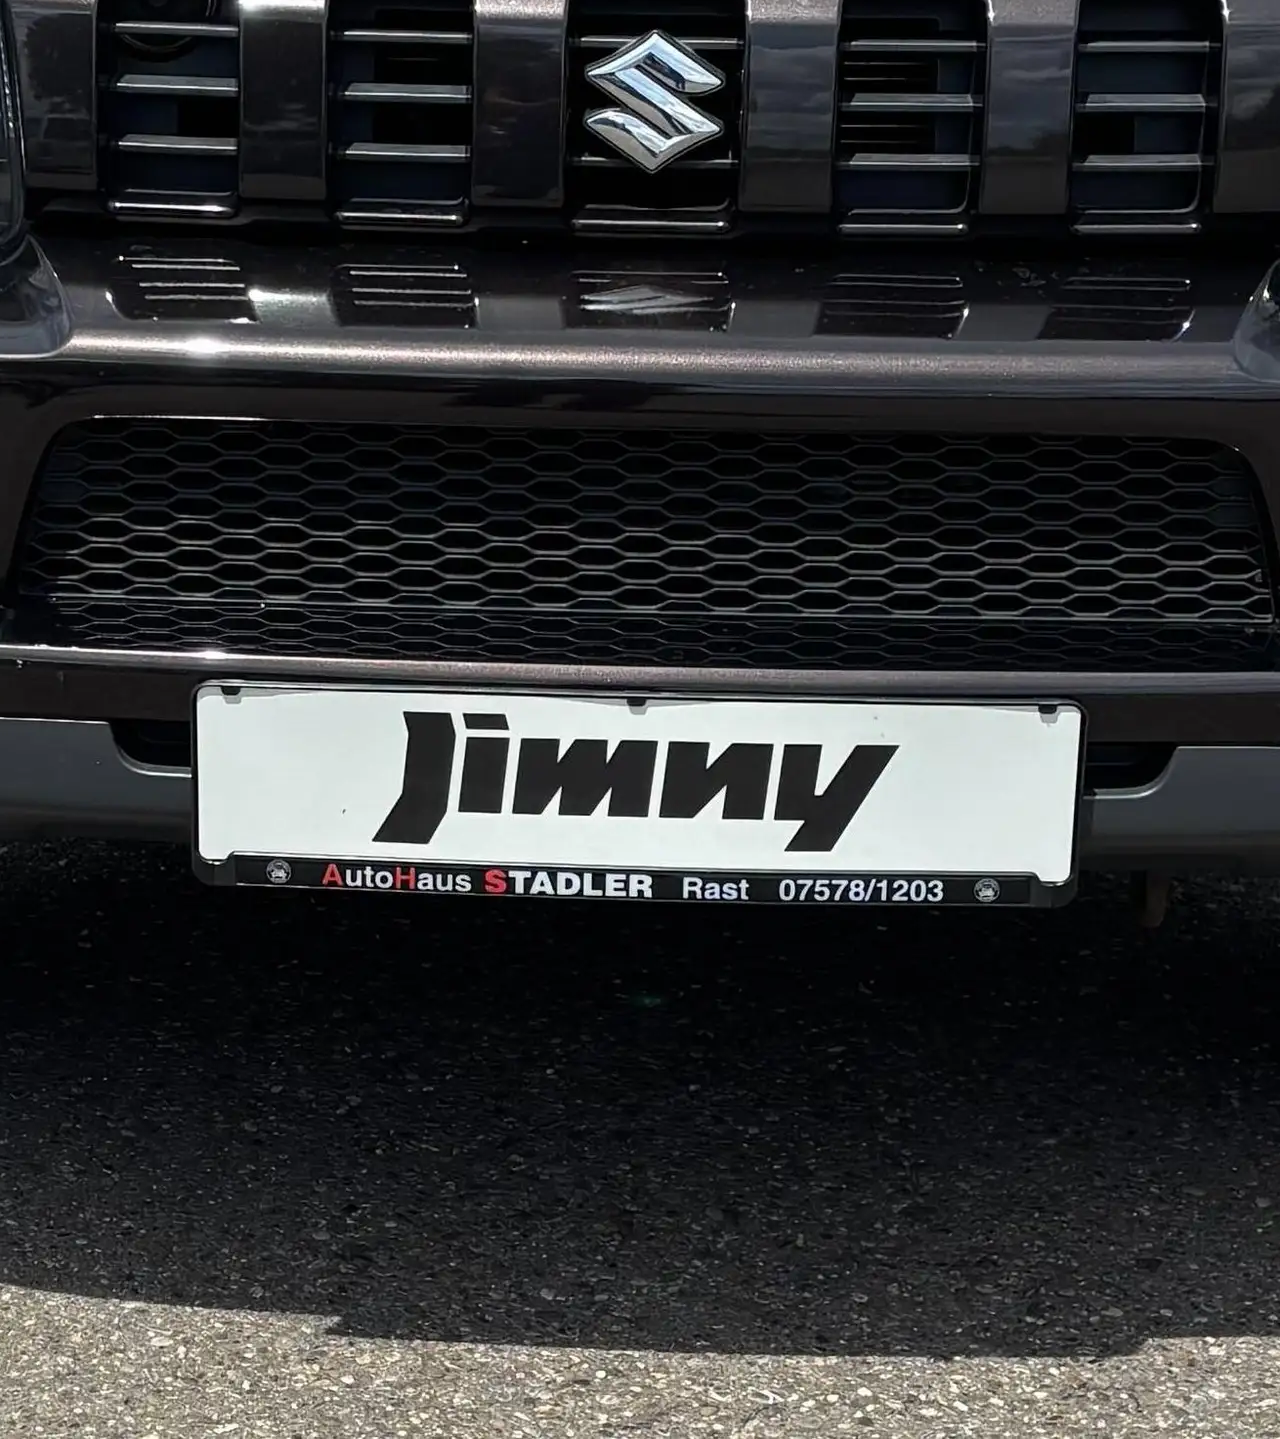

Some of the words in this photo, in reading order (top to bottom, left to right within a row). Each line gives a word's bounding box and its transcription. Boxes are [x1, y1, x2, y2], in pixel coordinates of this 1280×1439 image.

[372, 710, 900, 852] Jimny
[322, 863, 472, 892] AutoHaus
[484, 868, 653, 898] STADLER
[682, 876, 750, 901] Rast
[778, 877, 944, 902] 07578/1203
